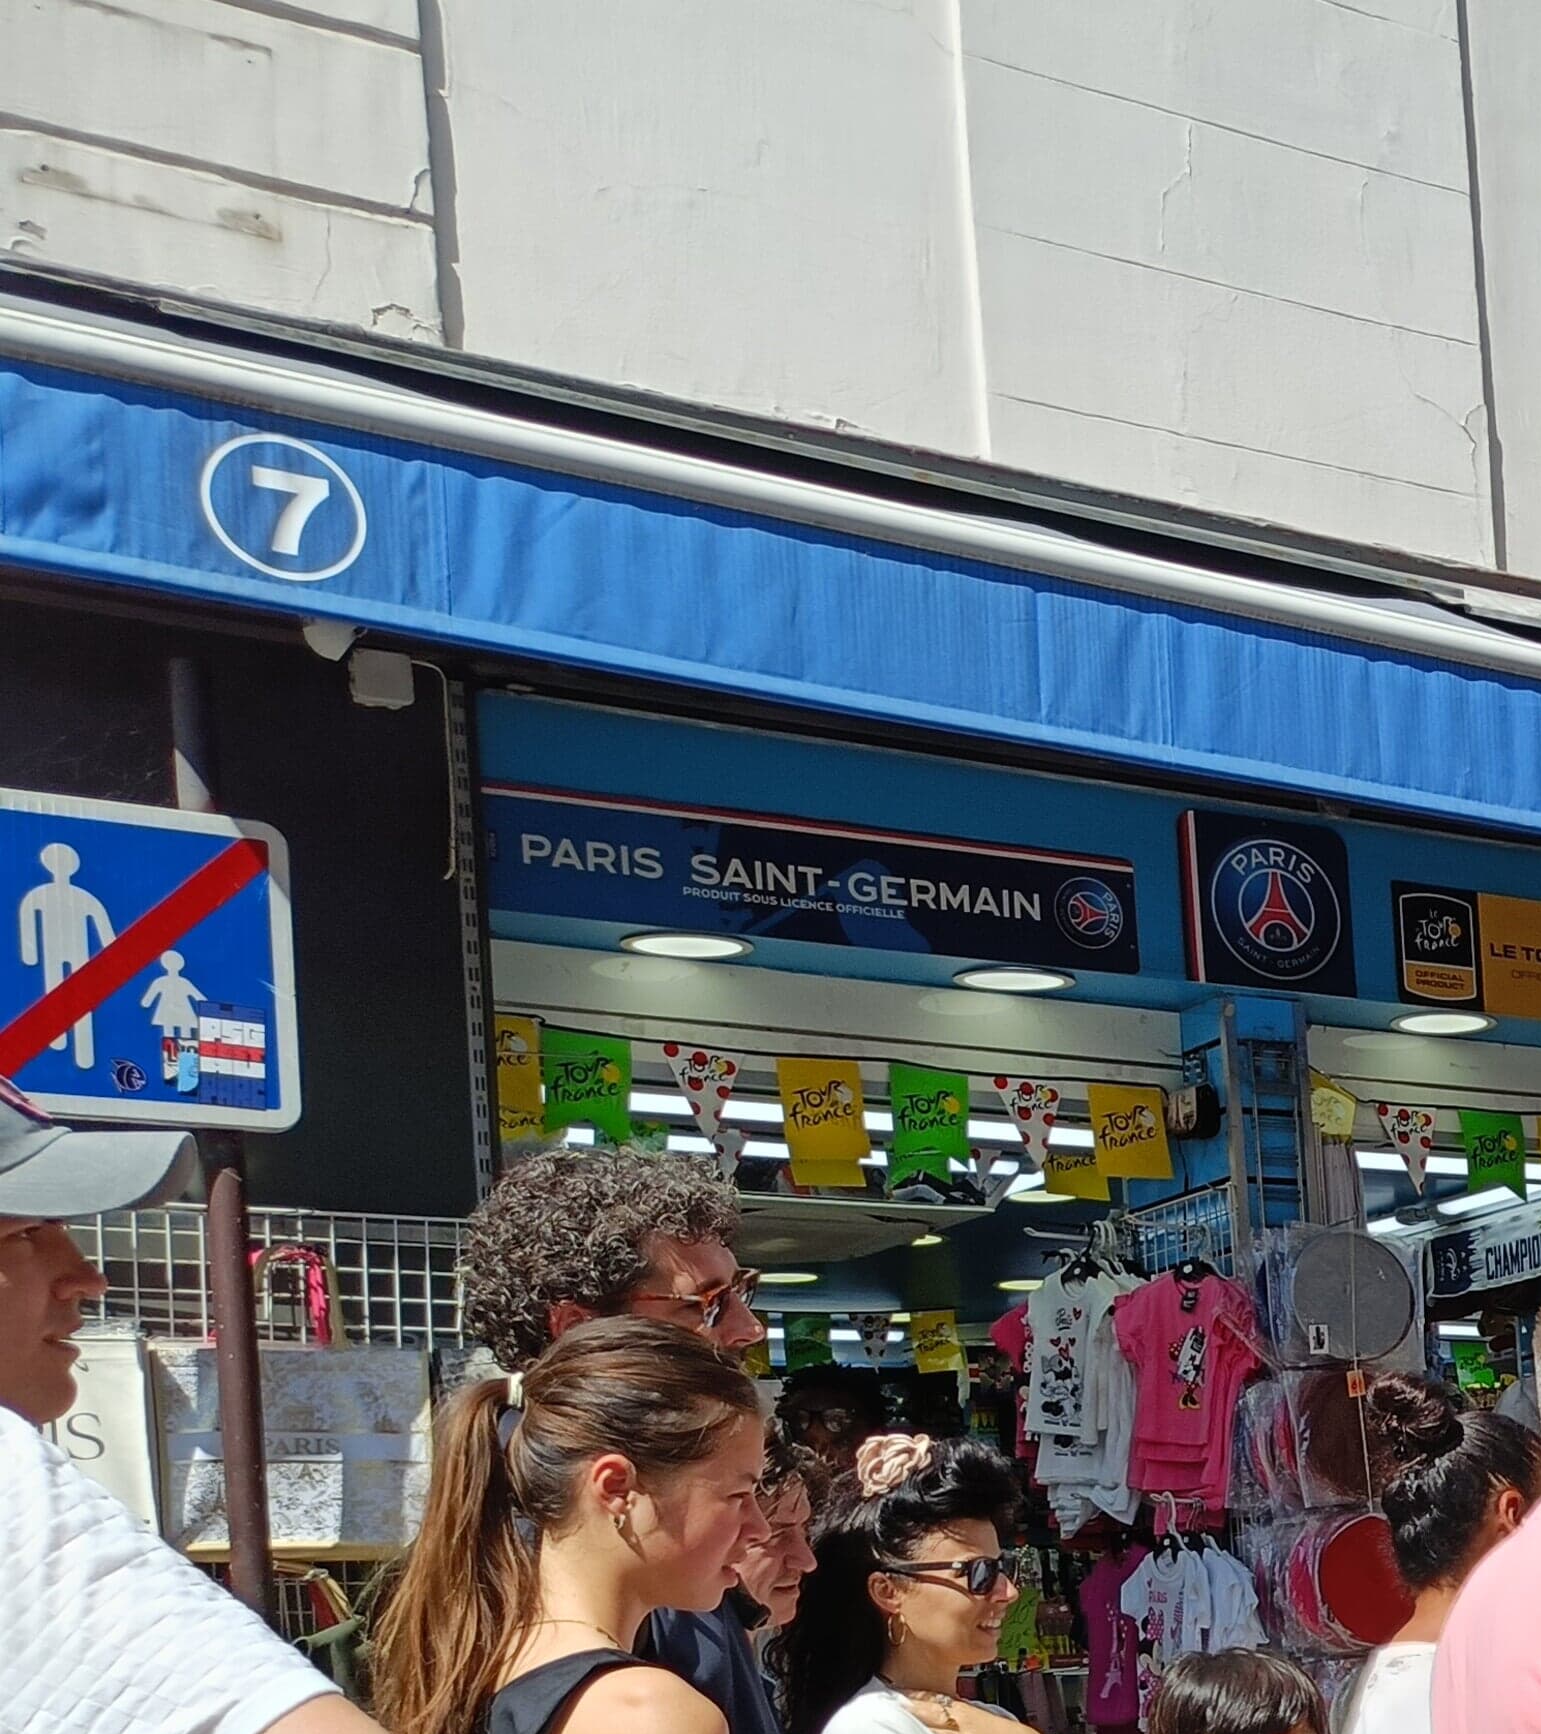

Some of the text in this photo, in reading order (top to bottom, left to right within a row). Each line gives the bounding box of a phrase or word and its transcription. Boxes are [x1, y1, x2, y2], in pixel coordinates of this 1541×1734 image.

[251, 465, 330, 556] 7
[521, 832, 665, 880] PARIS
[1230, 847, 1316, 885] PARIS
[682, 885, 905, 920] PRODUIT SOUS LICENCE OFFICIELLE
[1101, 890, 1122, 939] PARIS
[1489, 942, 1518, 960] LE
[1415, 969, 1465, 982] OFFICIAL
[1416, 978, 1465, 991] PRODUCT
